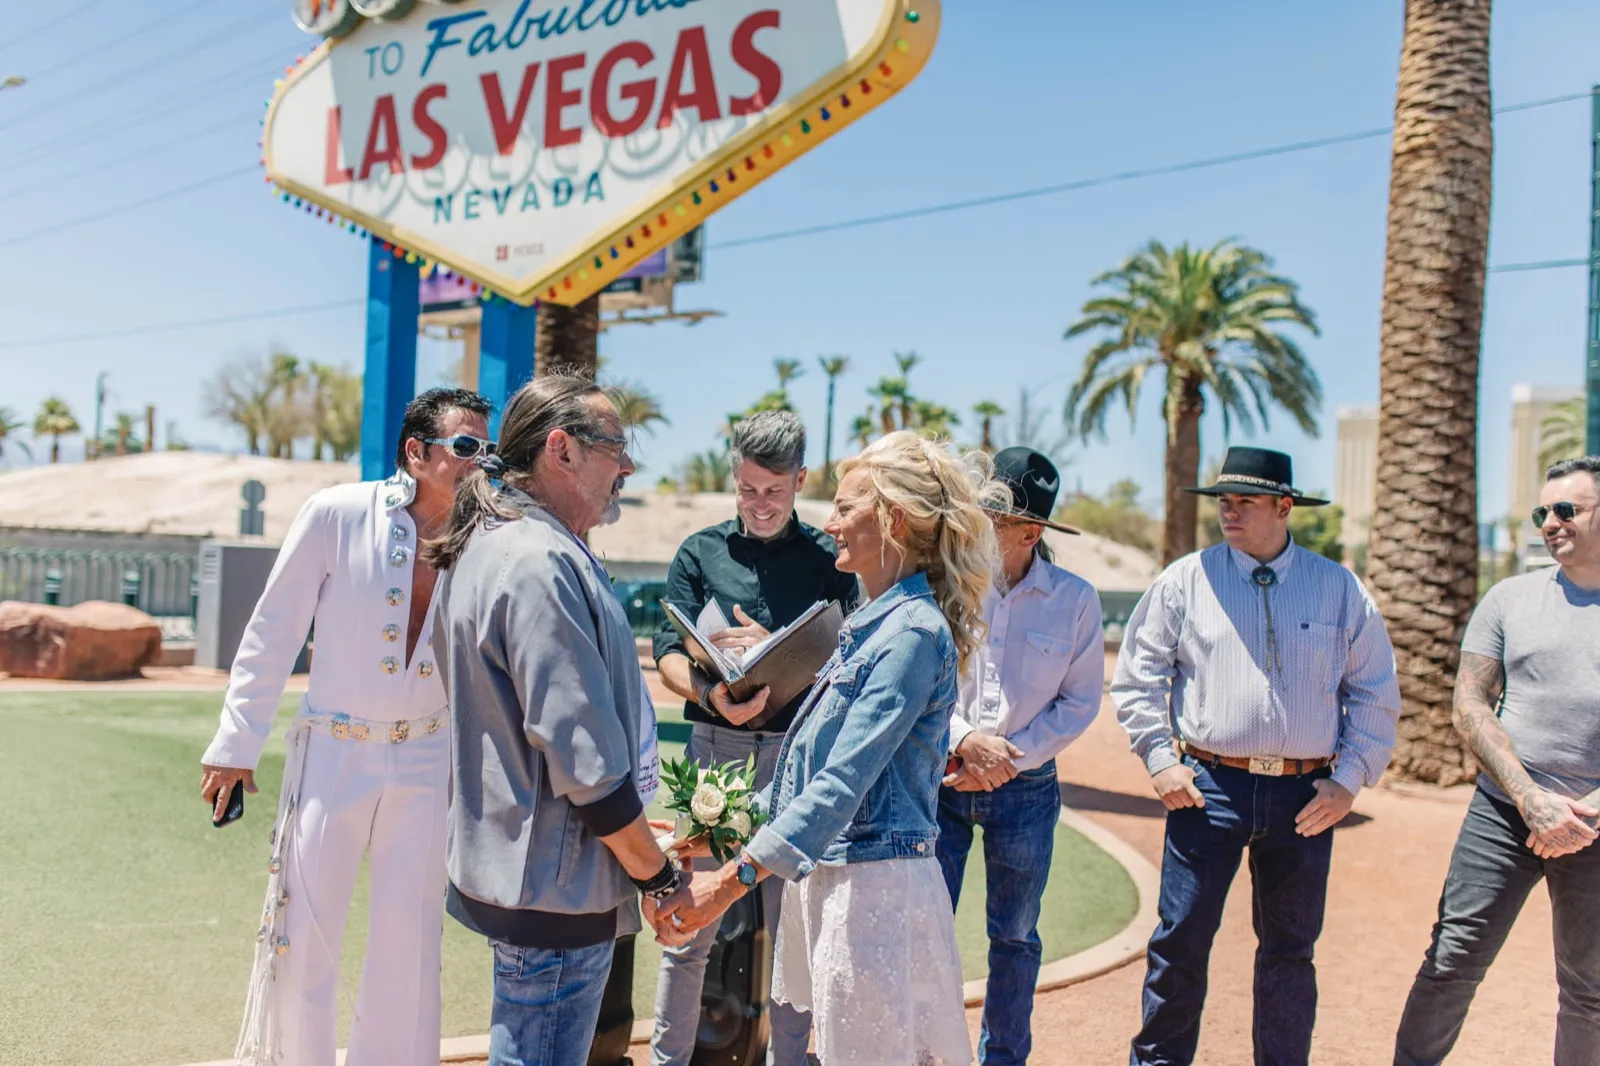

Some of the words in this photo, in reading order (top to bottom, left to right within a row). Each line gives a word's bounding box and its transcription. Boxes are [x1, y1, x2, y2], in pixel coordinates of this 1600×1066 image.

[364, 41, 404, 79] TO
[323, 82, 447, 186] LAS
[480, 10, 783, 157] VEGAS
[433, 171, 606, 225] NEVADA
